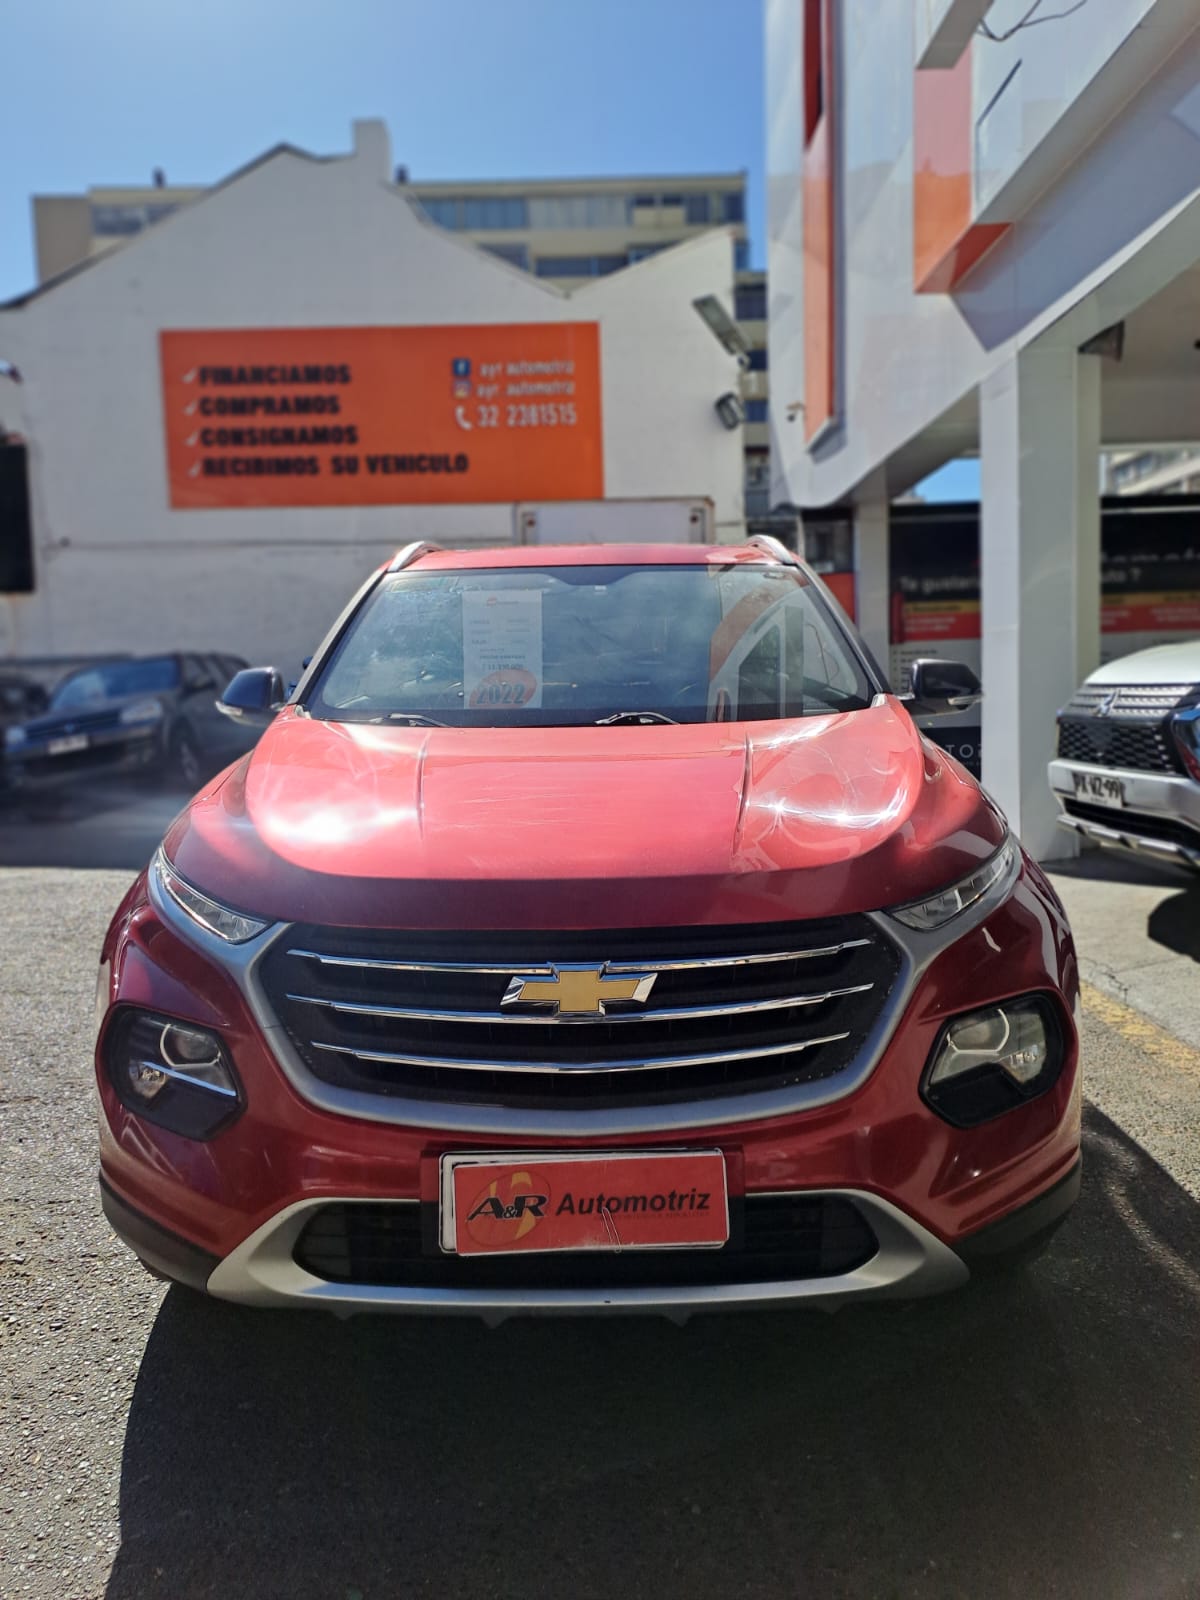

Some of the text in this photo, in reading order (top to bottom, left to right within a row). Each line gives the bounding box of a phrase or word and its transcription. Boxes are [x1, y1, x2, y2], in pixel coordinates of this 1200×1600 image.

[199, 364, 351, 385] FINANCIAMOS
[199, 395, 340, 416] COMPRAMOS
[200, 426, 358, 447] CONSIGNAMOS
[202, 453, 469, 477] RECIBIMOS SU VEHICULO
[475, 683, 526, 705] 2022
[467, 1188, 711, 1221] A&R Automotriz
